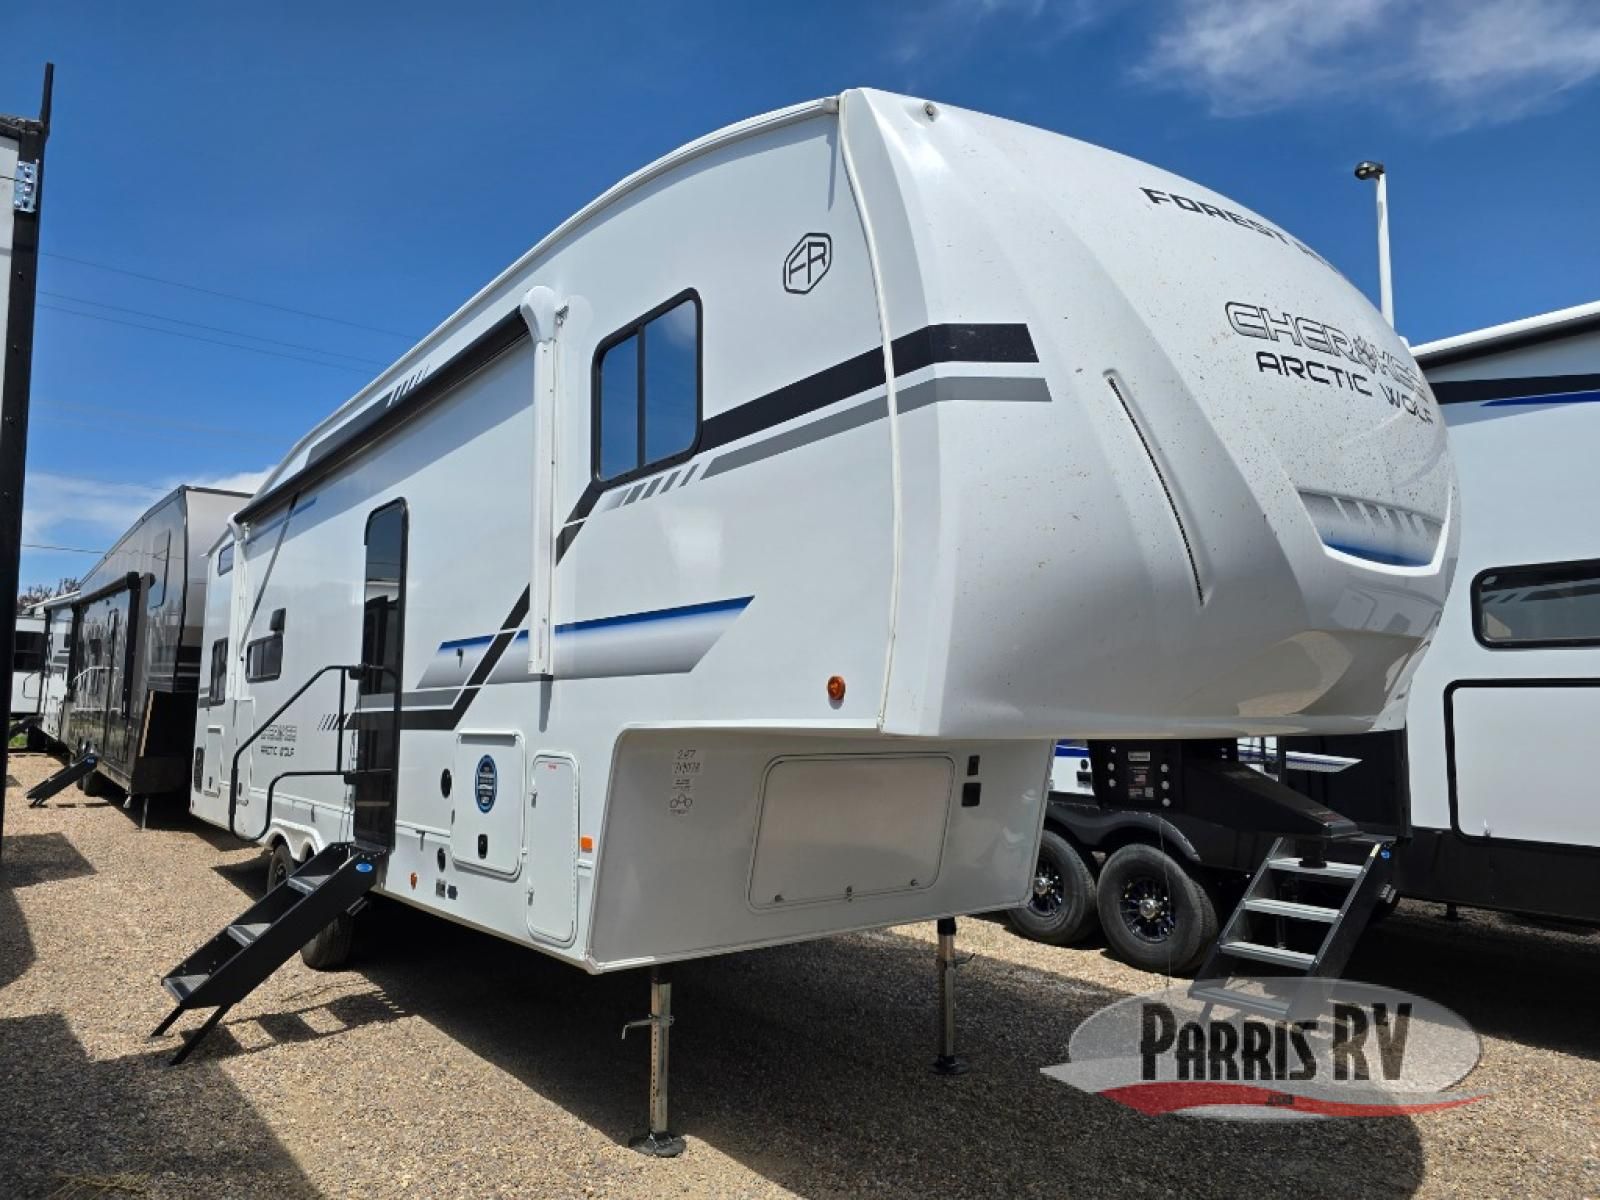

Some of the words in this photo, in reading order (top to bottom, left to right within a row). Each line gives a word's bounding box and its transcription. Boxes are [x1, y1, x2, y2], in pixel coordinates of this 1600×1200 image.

[1139, 187, 1290, 245] FOREST
[1255, 351, 1373, 398] ARCTIC
[1379, 382, 1434, 425] WOLF
